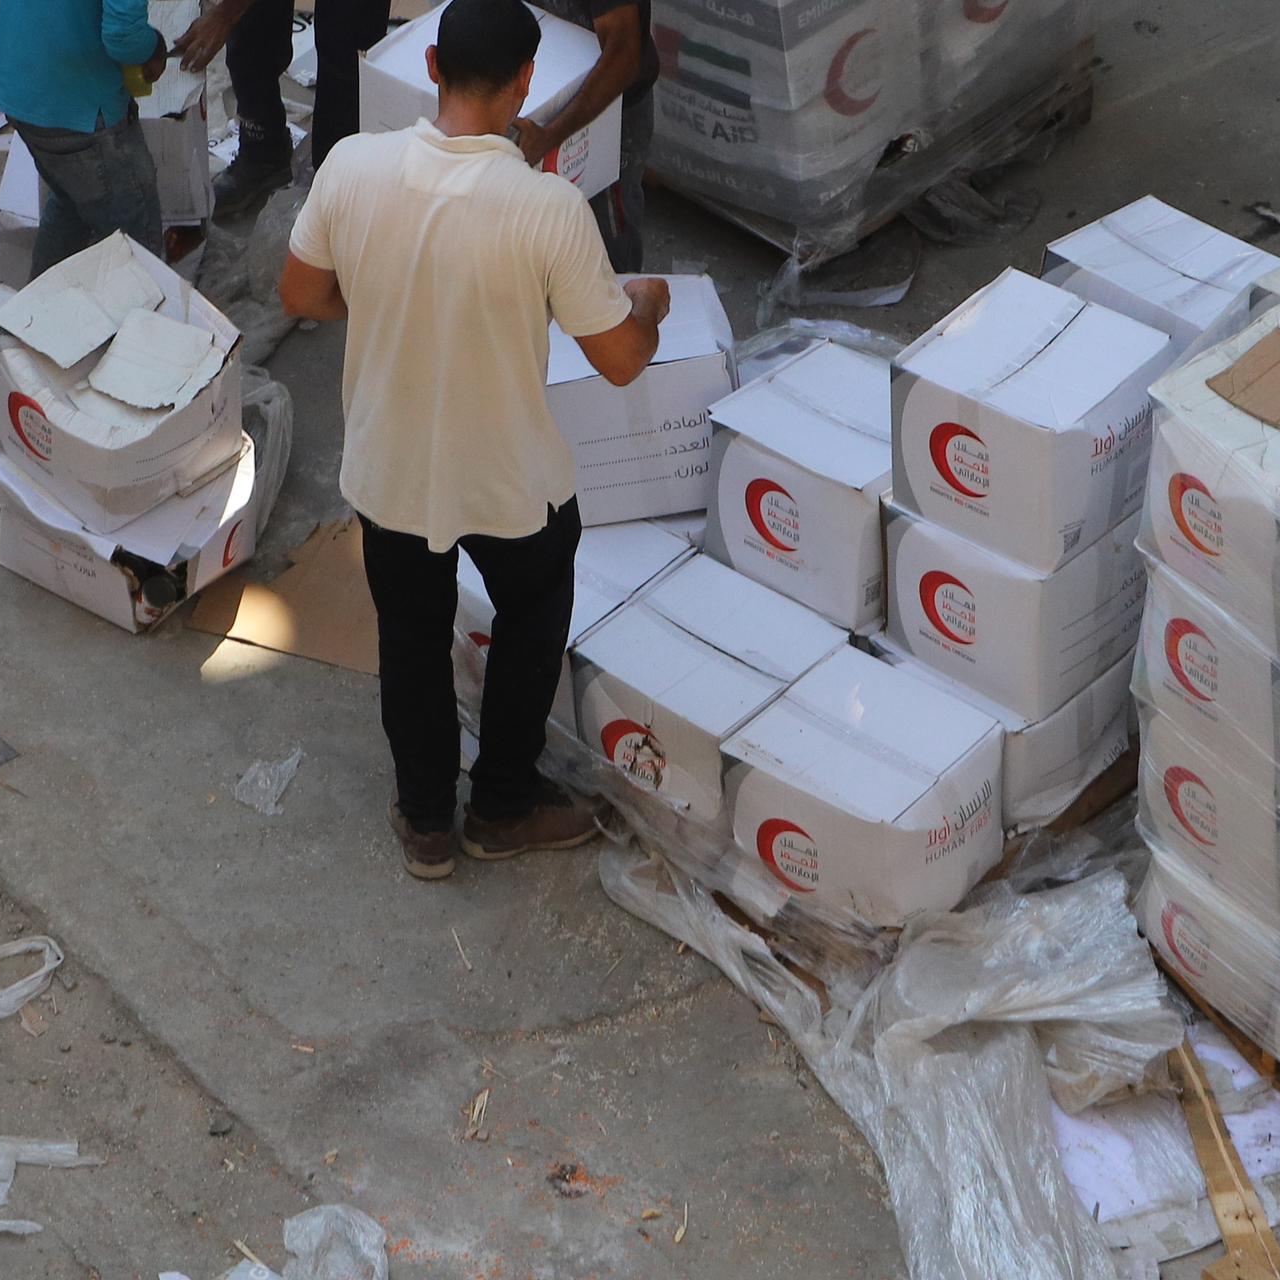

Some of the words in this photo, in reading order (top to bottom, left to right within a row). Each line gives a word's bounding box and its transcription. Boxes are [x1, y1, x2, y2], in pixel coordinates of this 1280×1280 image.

[711, 122, 759, 144] AID
[658, 411, 708, 434] المادة:
[663, 436, 711, 457] العدد:
[673, 460, 710, 480] لوزن:
[953, 777, 993, 831] الإنسان
[924, 834, 966, 865] HUMAN
[969, 806, 993, 841] FIRST
